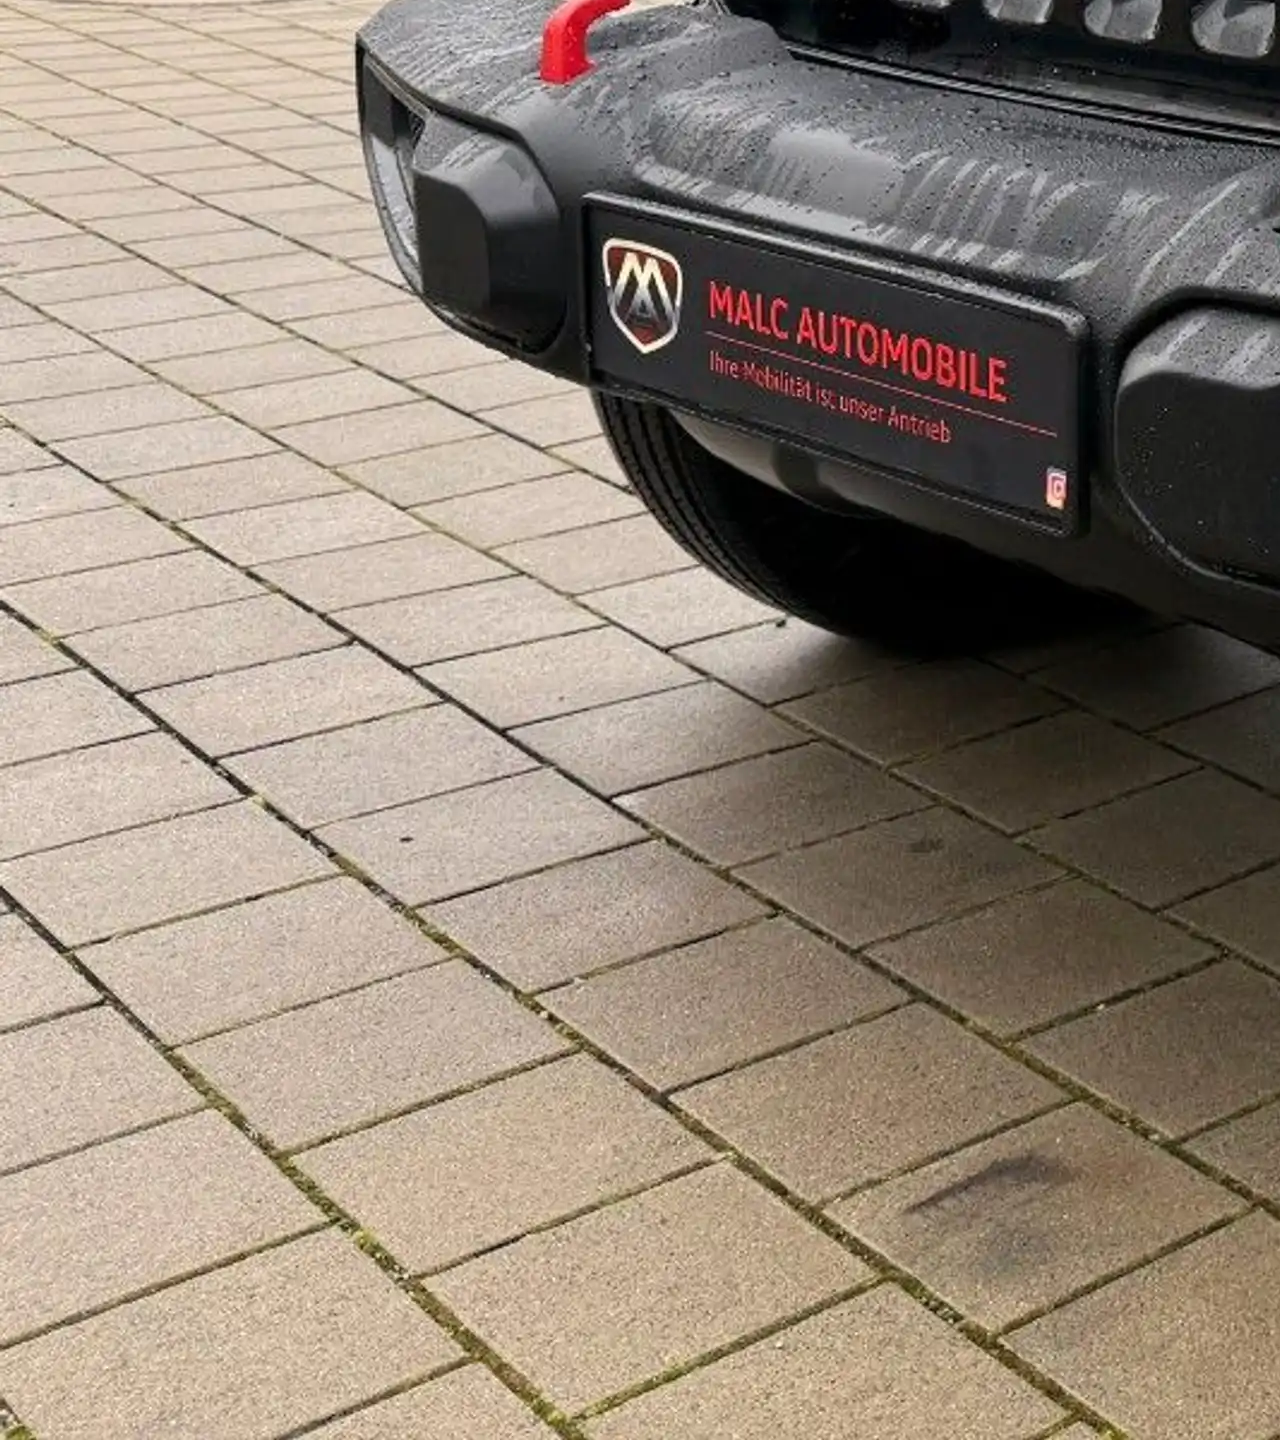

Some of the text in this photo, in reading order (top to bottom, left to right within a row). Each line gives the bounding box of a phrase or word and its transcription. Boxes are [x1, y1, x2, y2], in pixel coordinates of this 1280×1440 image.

[708, 280, 1008, 404] MALC AUTOMOBILE
[709, 350, 952, 444] Ihre Mobilität ist unser Antrieb
